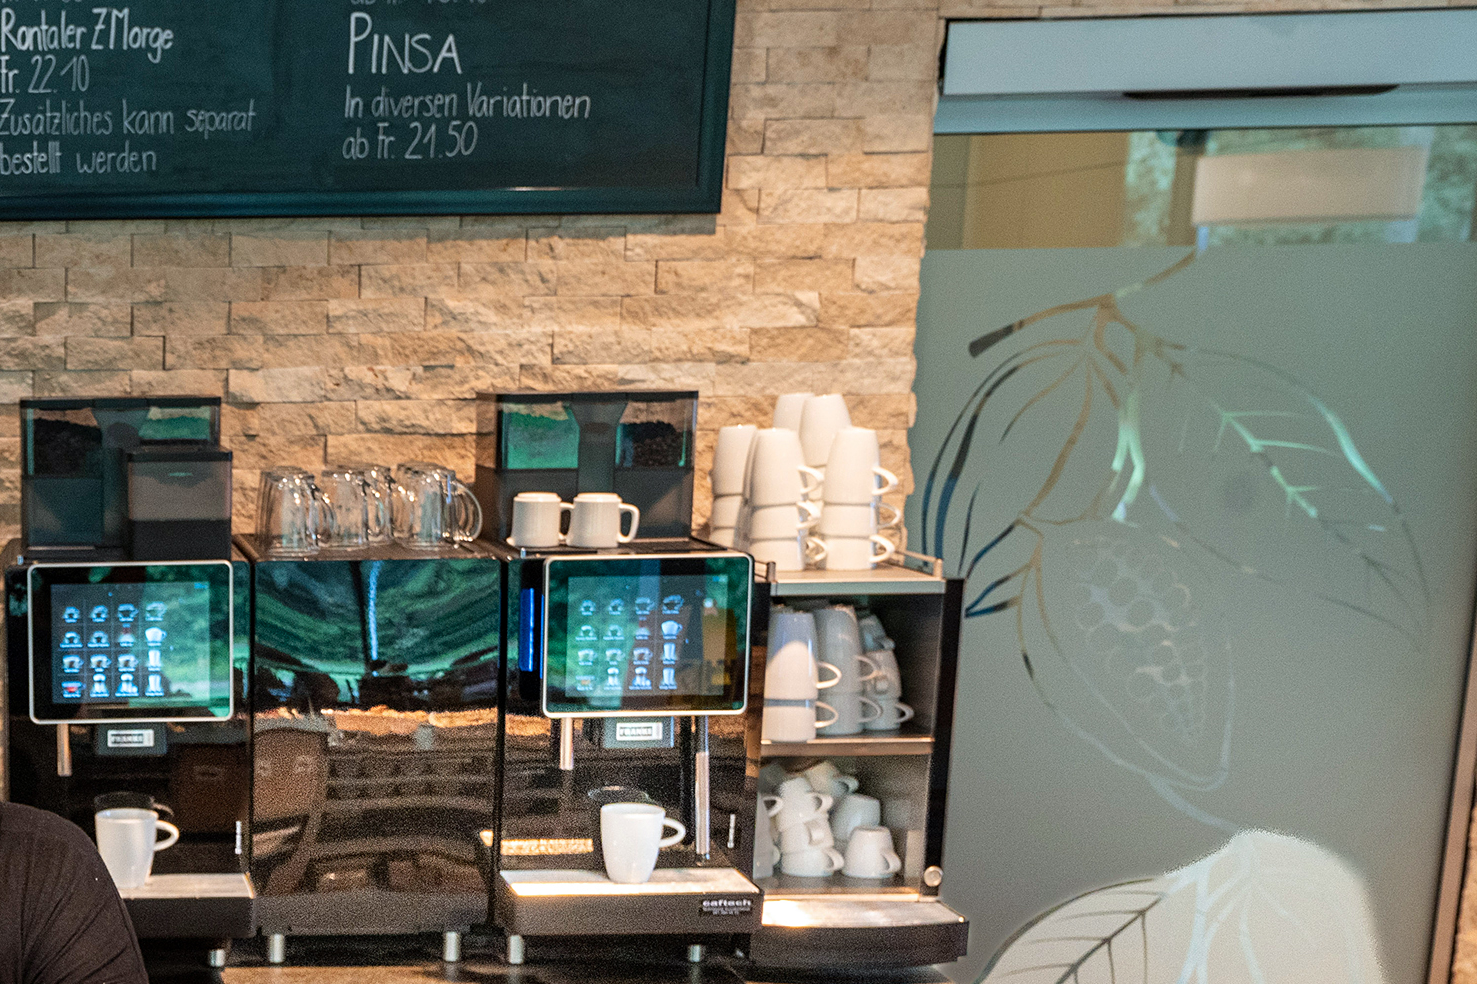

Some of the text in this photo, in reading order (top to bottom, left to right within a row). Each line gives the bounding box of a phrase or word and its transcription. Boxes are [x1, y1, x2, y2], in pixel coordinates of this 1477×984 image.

[347, 11, 463, 75] PINSA
[26, 54, 90, 94] 22.10
[122, 98, 175, 135] kann
[184, 98, 258, 140] separat
[344, 81, 592, 119] In diversen Variationen
[75, 139, 158, 174] werden
[341, 120, 479, 160] ab Fr. 21.50
